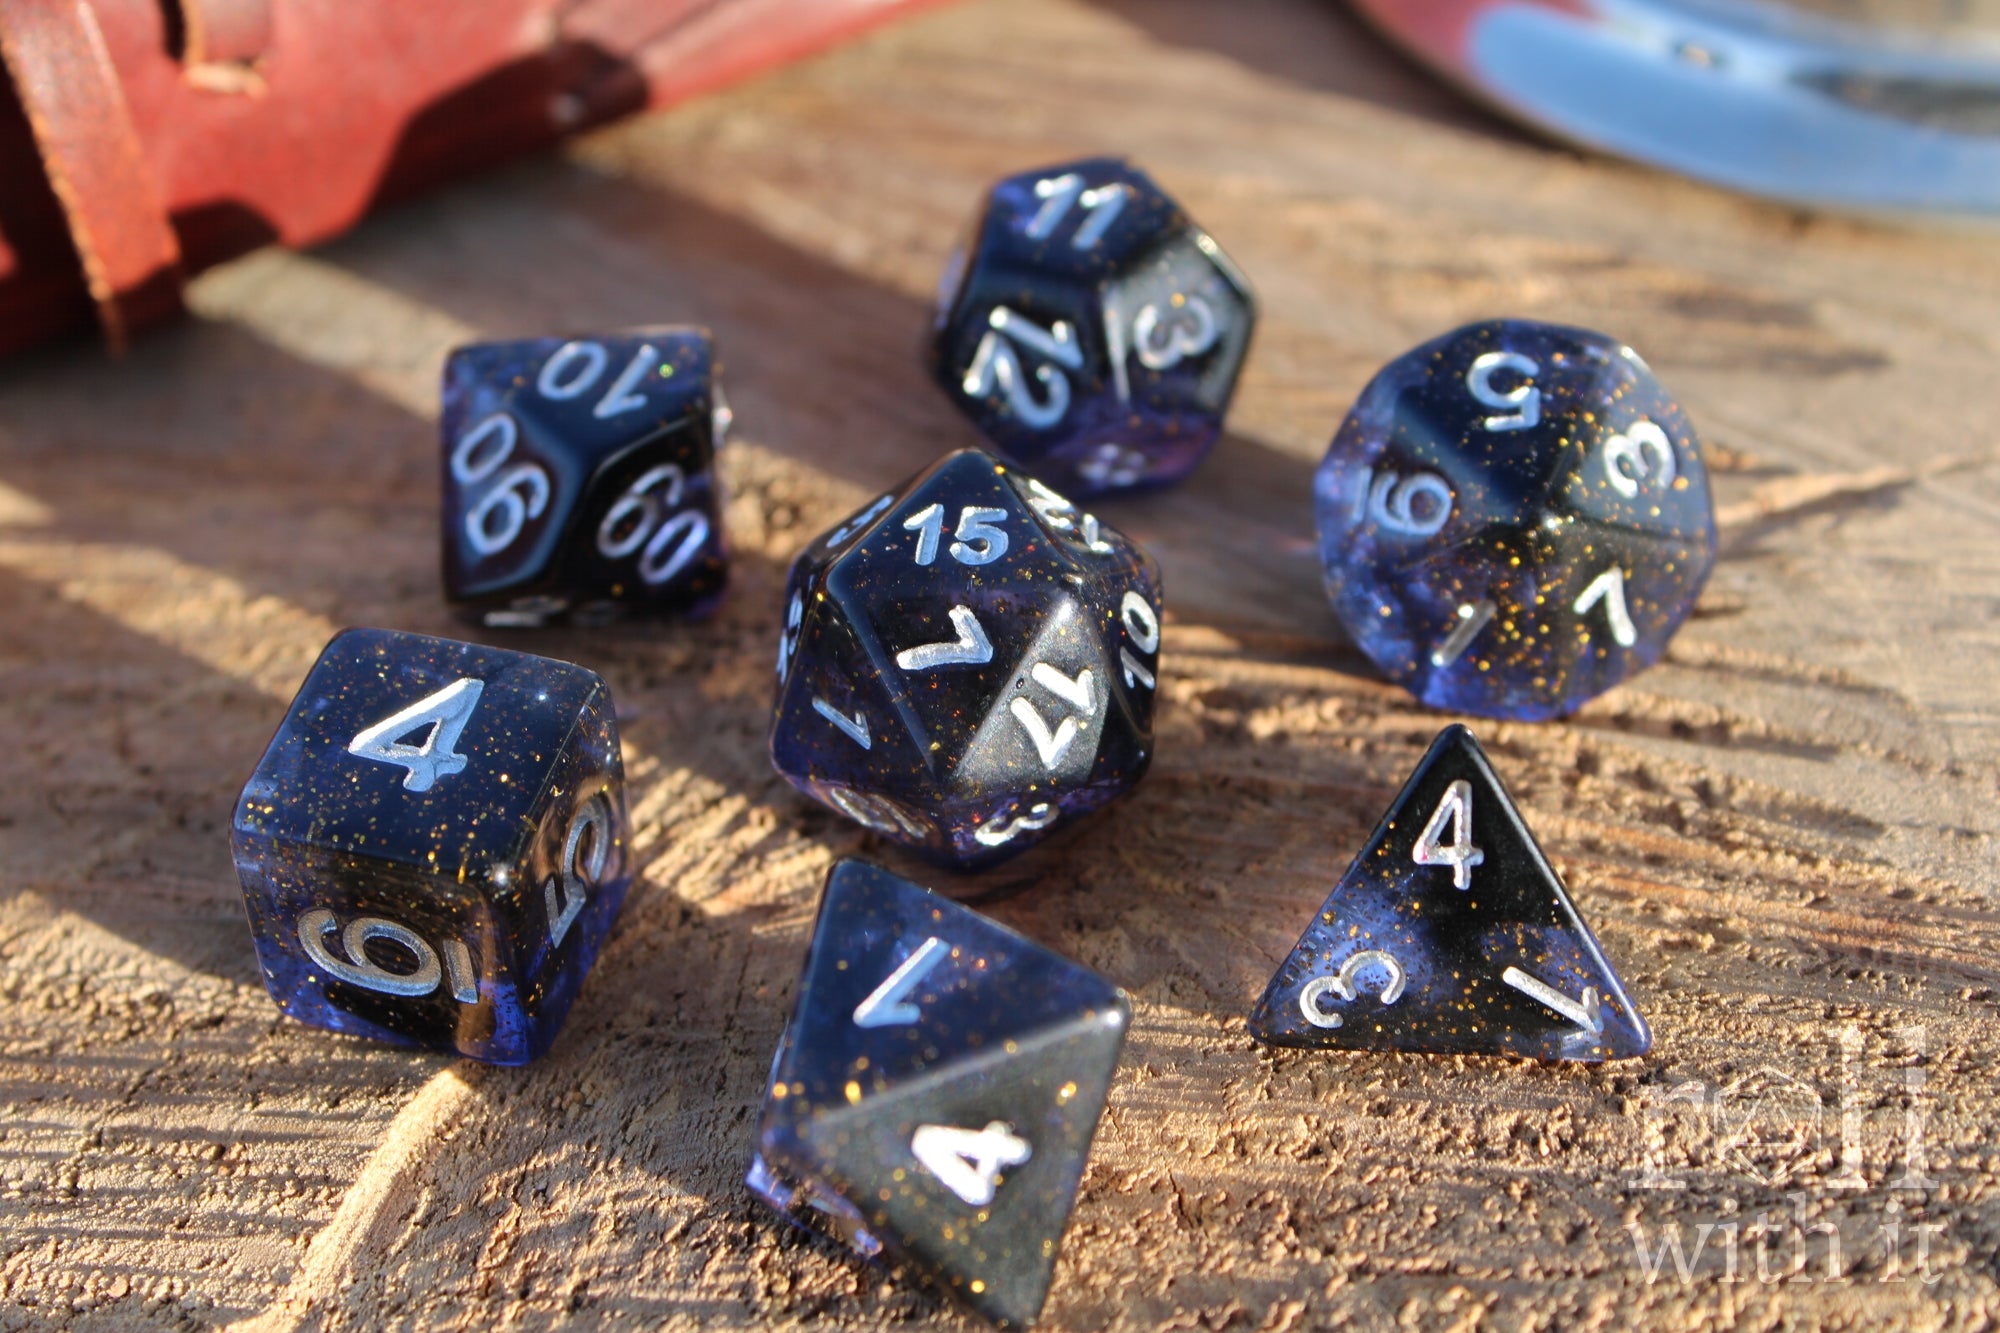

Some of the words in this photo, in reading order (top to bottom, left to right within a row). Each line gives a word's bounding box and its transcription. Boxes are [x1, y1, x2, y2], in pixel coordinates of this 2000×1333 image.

[1025, 173, 1127, 251] 11
[962, 304, 1084, 430] 12
[1133, 296, 1216, 371] 3
[537, 340, 659, 420] 10
[1466, 352, 1540, 432] 5
[1602, 420, 1677, 499] 3
[903, 502, 1010, 566] 15
[896, 604, 994, 671] 7
[1119, 590, 1161, 690] 10
[1572, 565, 1637, 648] 7
[347, 677, 486, 793] 4
[544, 795, 610, 950] 5
[1412, 779, 1486, 891] 4
[1299, 949, 1407, 1029] 3
[910, 1120, 1033, 1206] 4
